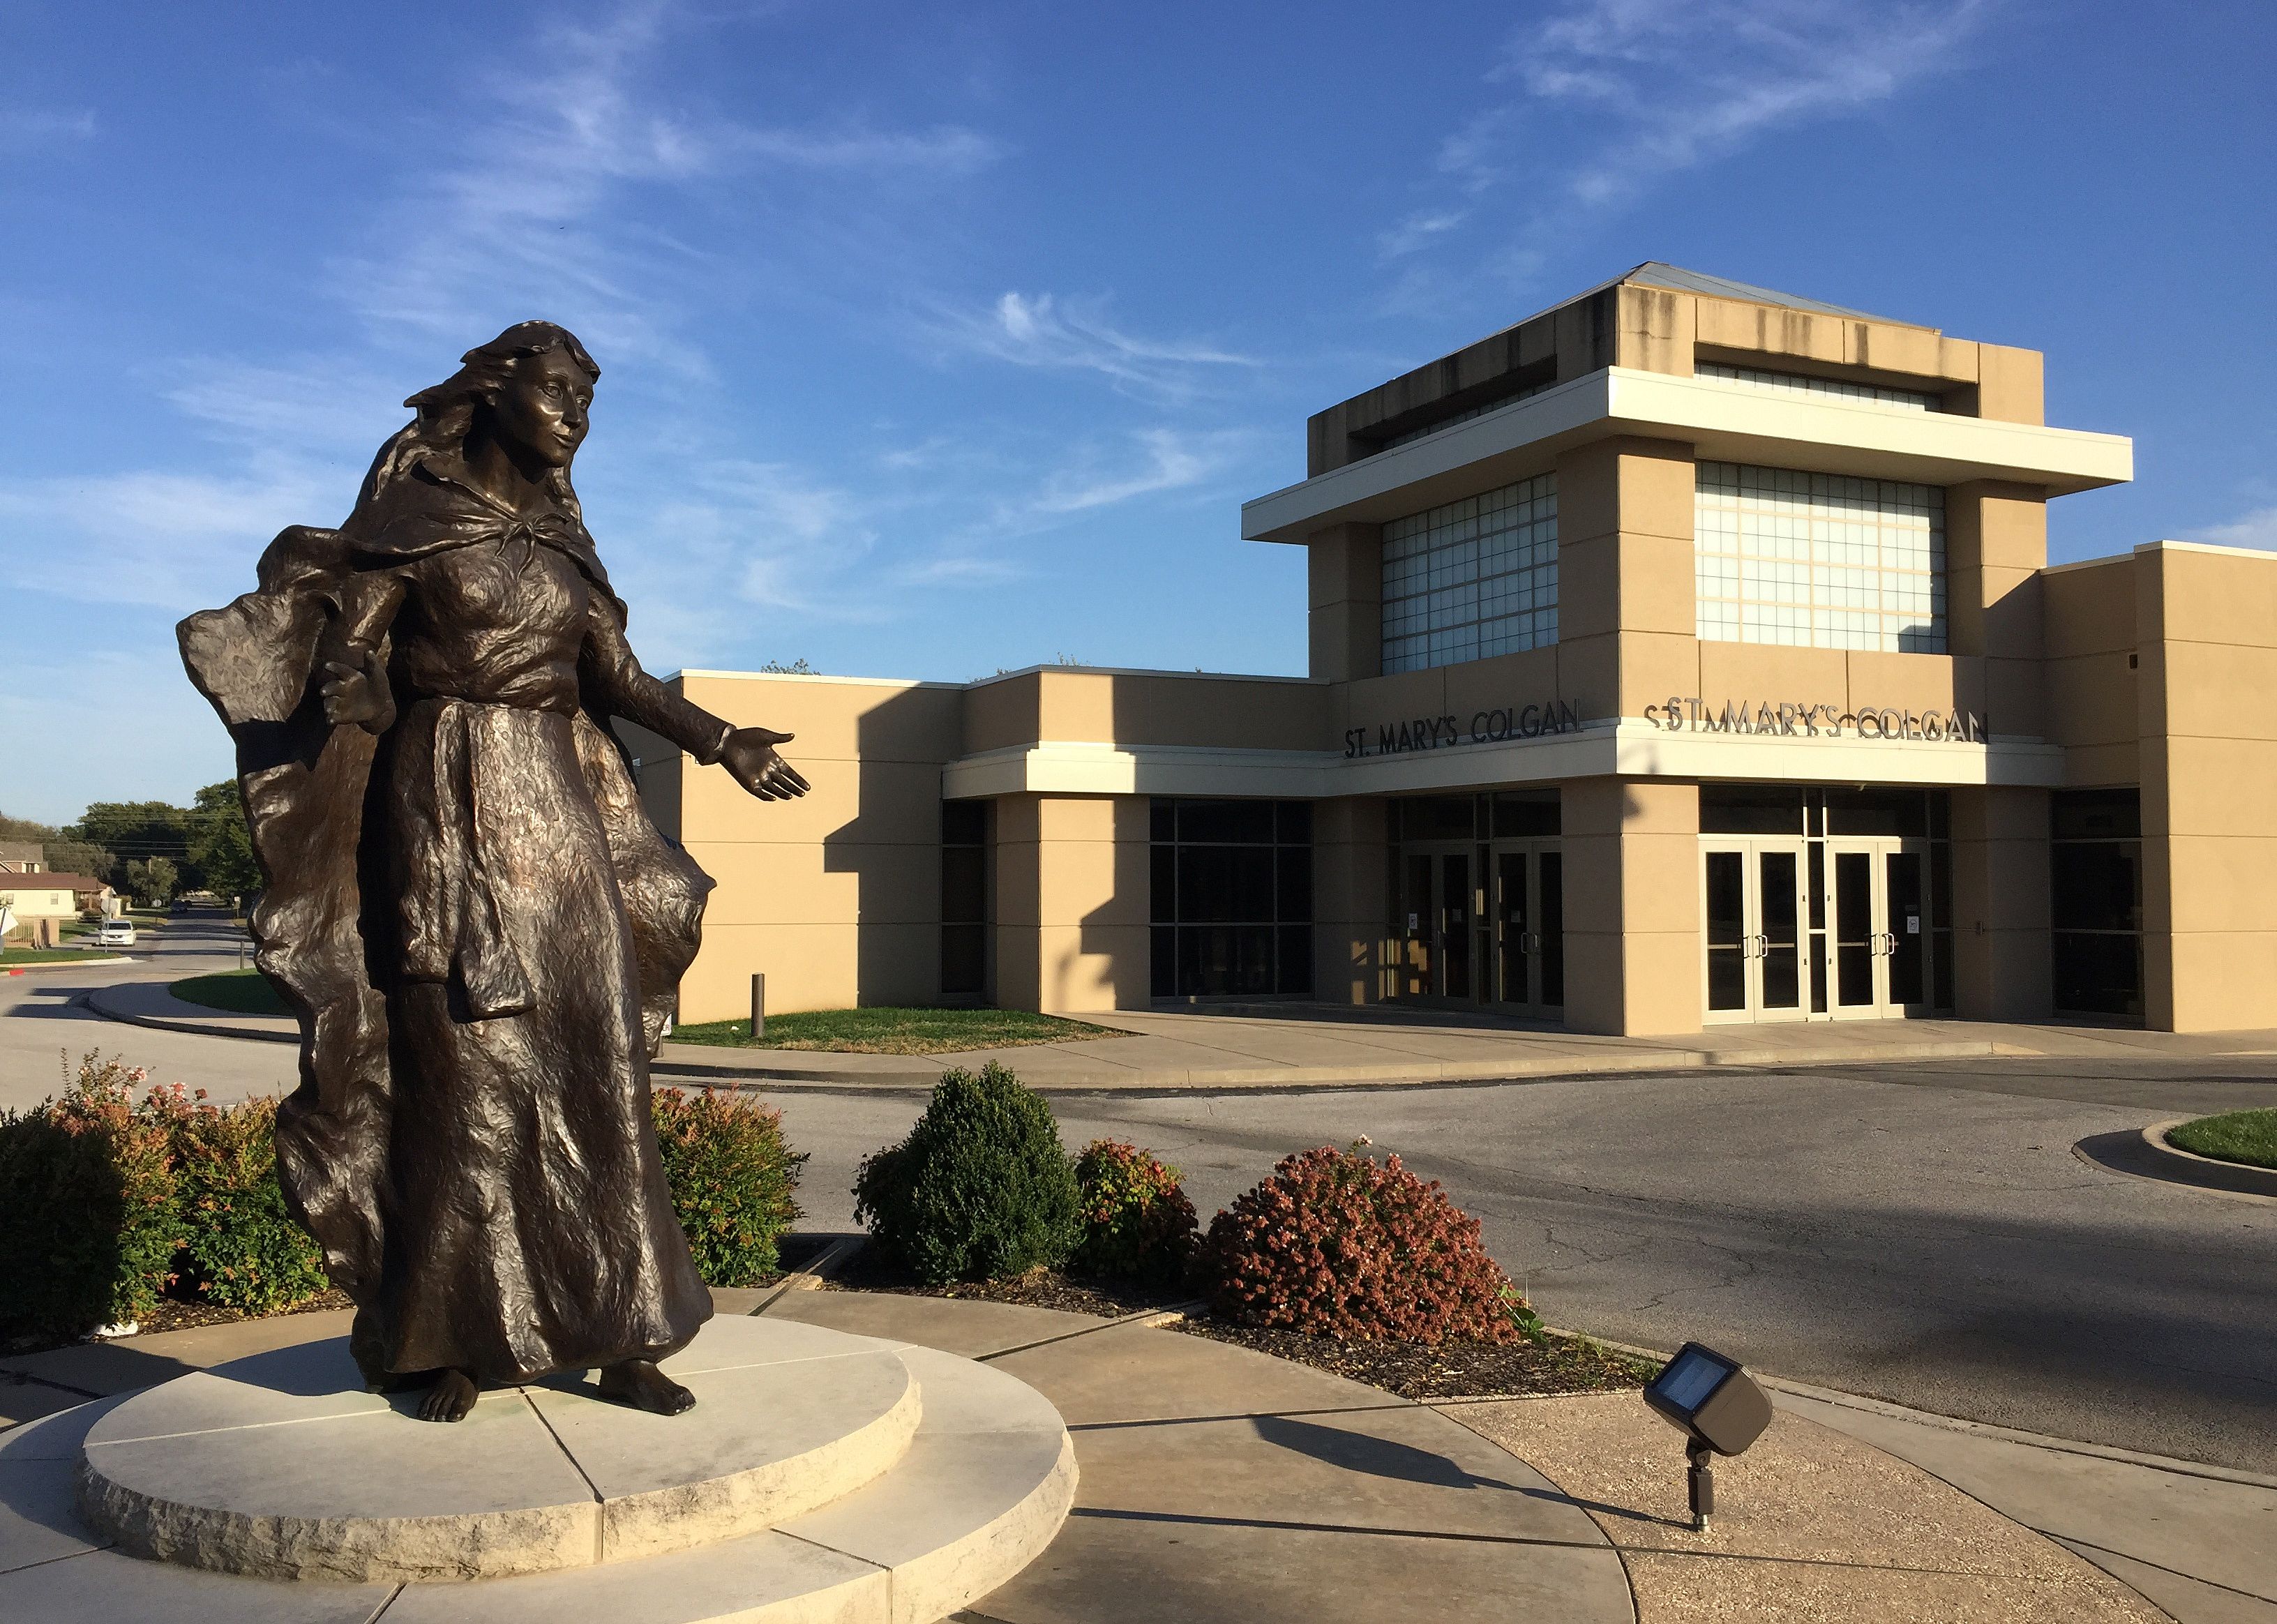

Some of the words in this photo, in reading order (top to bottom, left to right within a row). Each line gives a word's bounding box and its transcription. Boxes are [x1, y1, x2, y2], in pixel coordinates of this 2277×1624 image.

[1344, 727, 1370, 758] ST.
[1378, 715, 1458, 753] MARY'S
[1471, 698, 1580, 743] COLGAN
[1724, 699, 1841, 737] MARY'S
[1856, 707, 1988, 744] COLGAN
